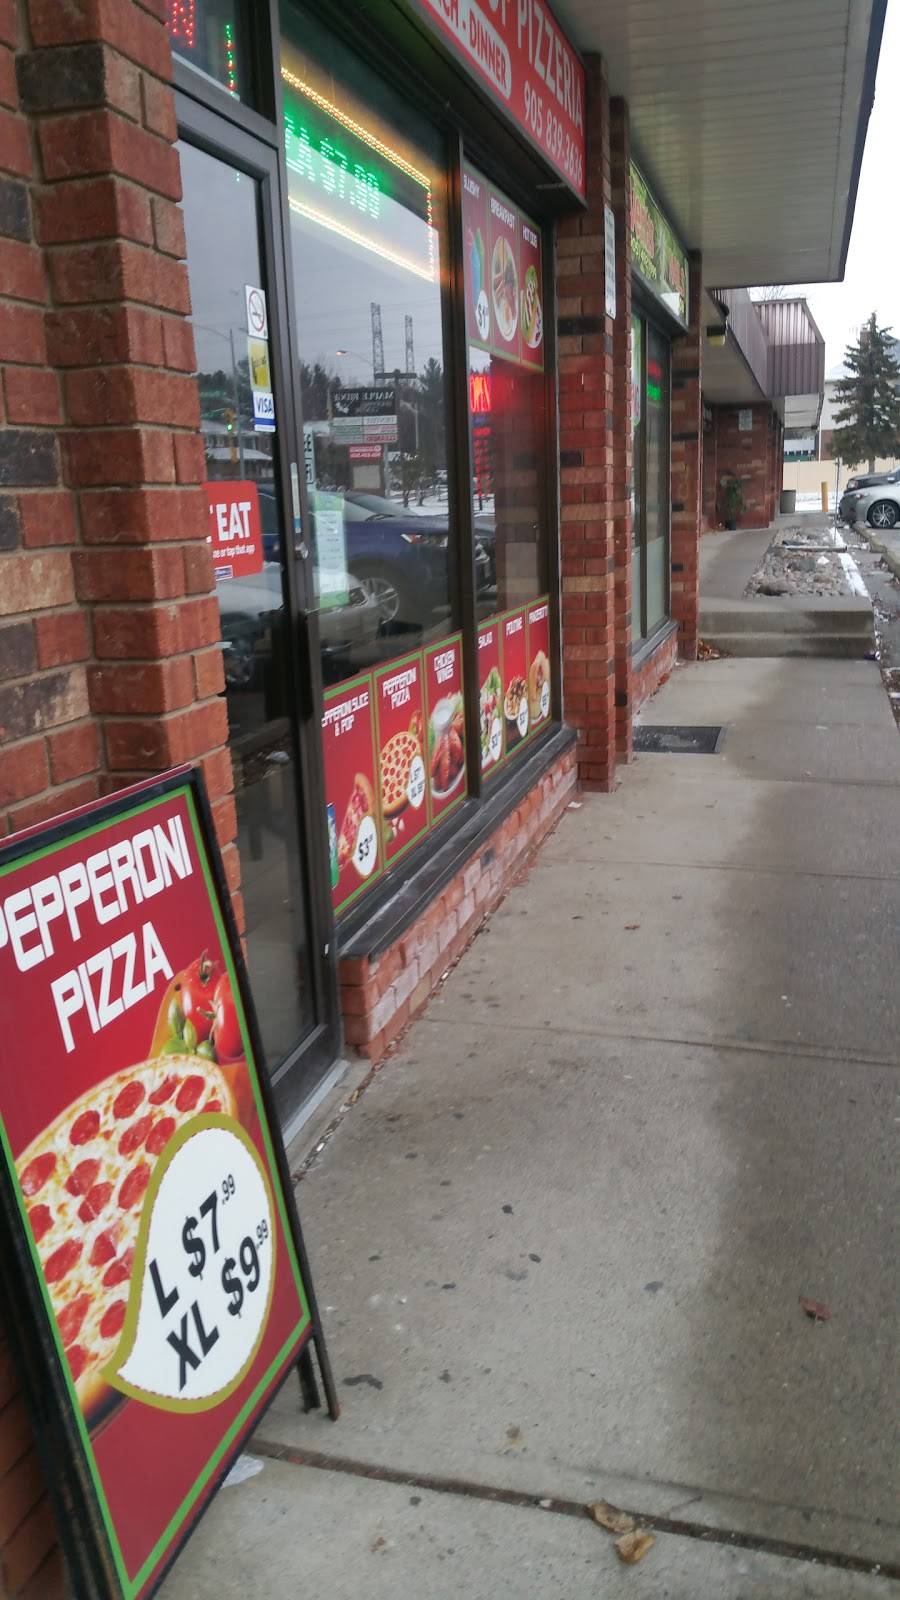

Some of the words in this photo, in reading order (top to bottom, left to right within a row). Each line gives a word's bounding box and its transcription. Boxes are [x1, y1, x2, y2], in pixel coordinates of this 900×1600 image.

[469, 8, 508, 92] DINNER
[524, 79, 543, 139] 905
[256, 395, 273, 417] VISA
[216, 502, 252, 542] EAT
[351, 691, 369, 712] SLICE
[382, 667, 417, 698] PEPPERONI
[390, 687, 411, 710] PIZZA
[50, 921, 175, 1054] PIZZA
[149, 1258, 180, 1340] L
[166, 1300, 220, 1393] XL
